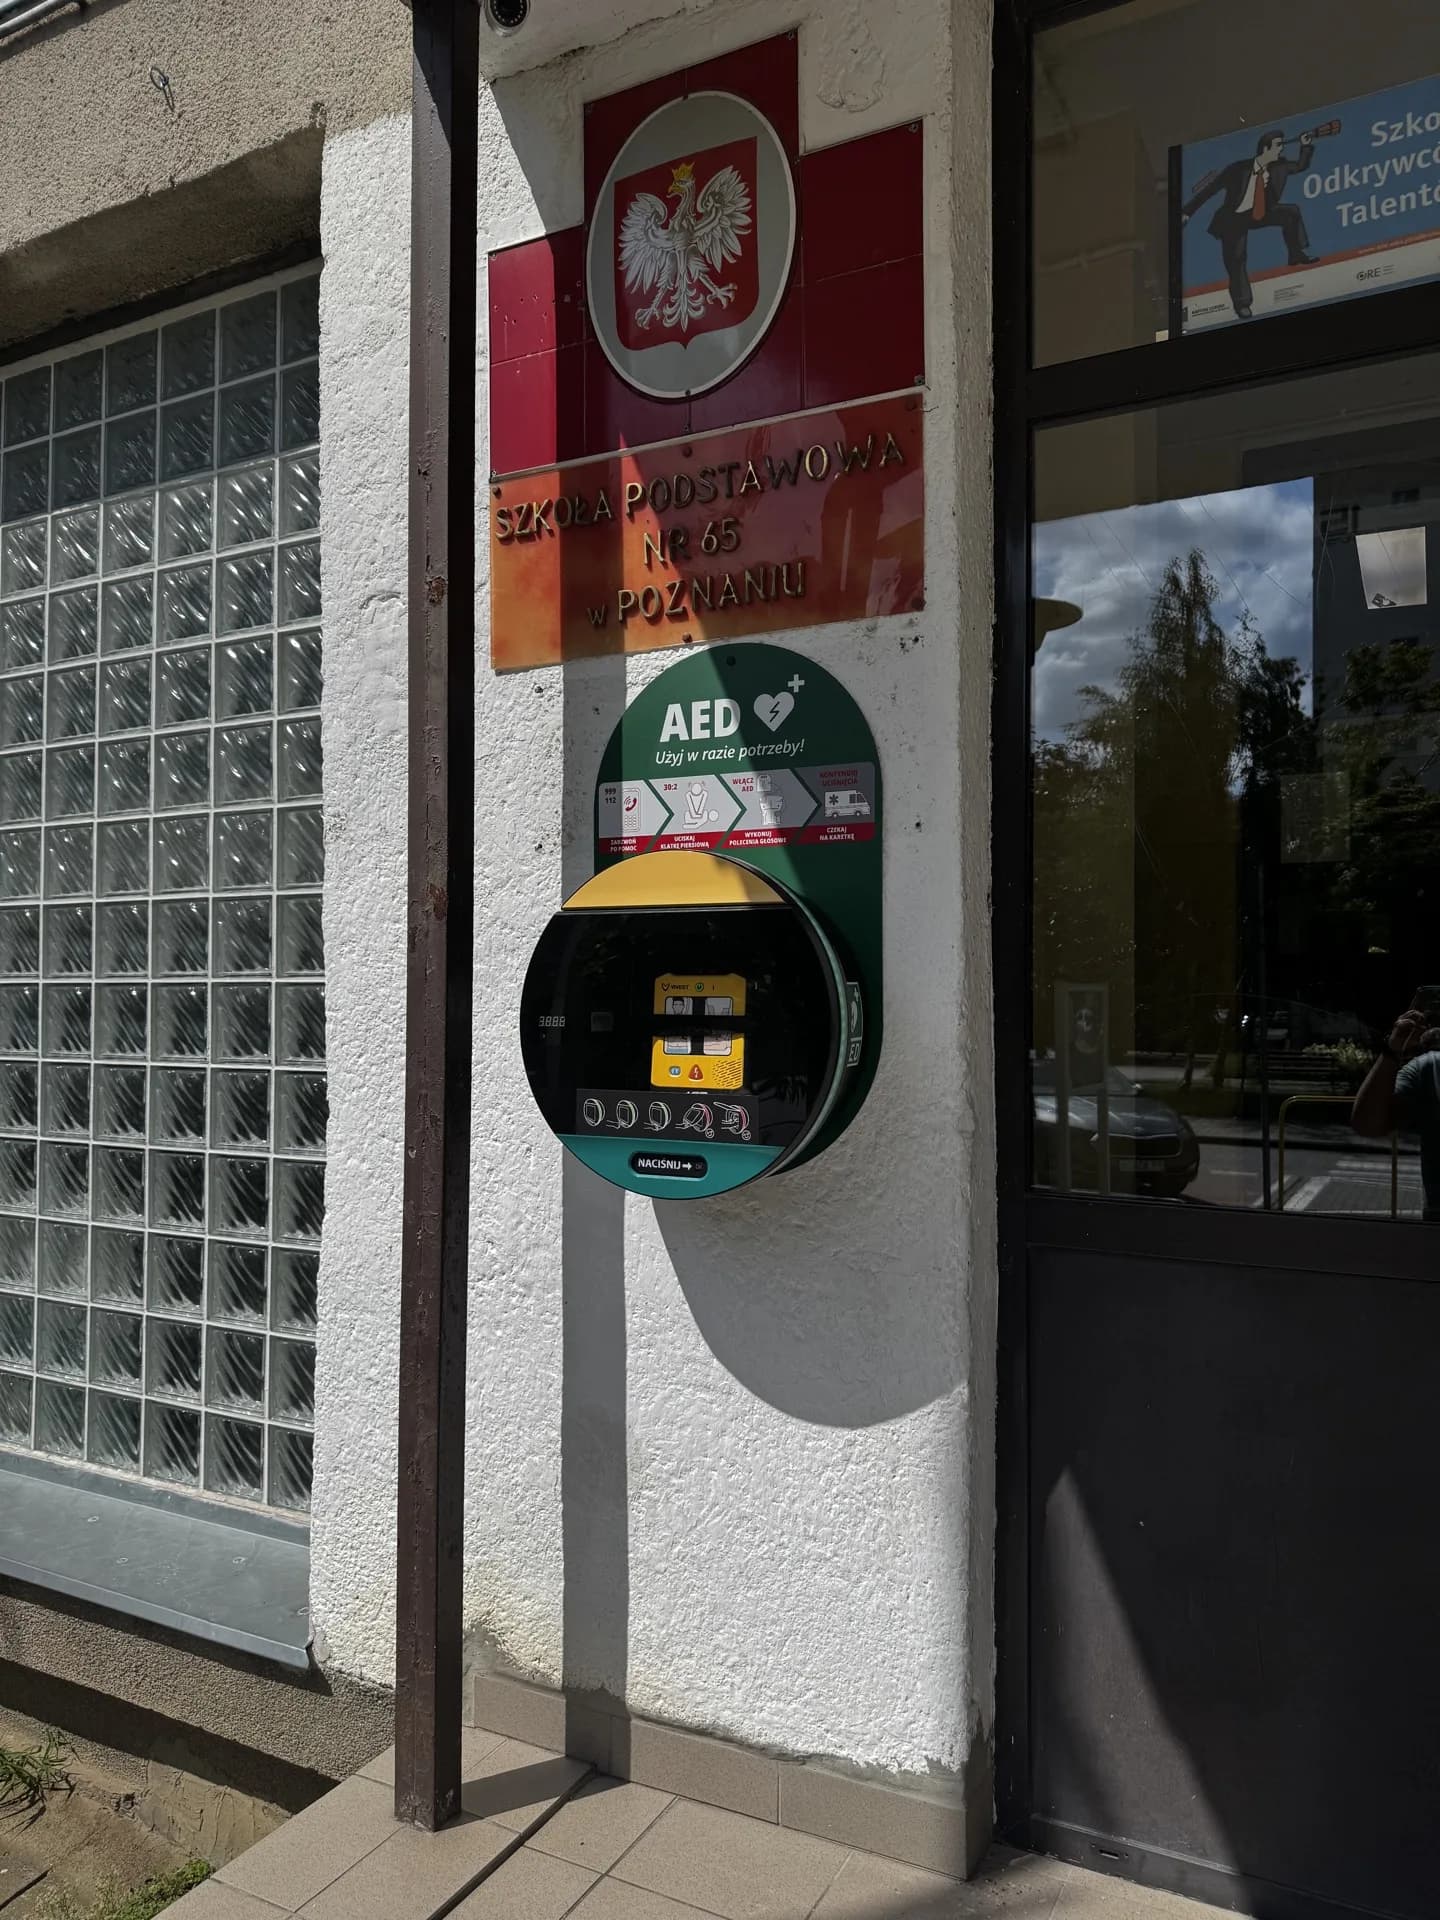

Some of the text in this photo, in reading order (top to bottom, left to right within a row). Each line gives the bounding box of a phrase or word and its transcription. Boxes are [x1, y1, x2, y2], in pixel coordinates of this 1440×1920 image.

[495, 432, 904, 540] SZKOŁA PODSTAWOWA
[643, 517, 740, 566] NR 65
[617, 561, 808, 623] POZNANIU
[659, 698, 741, 743] AED
[655, 738, 805, 767] Użyj w razie potrzeby!
[663, 783, 678, 791] 30:2
[741, 785, 754, 793] AED
[604, 788, 617, 796] 999
[604, 797, 617, 805] 112
[744, 832, 772, 840] WYKONUJ
[819, 834, 830, 842] NA
[618, 845, 639, 854] POMOC
